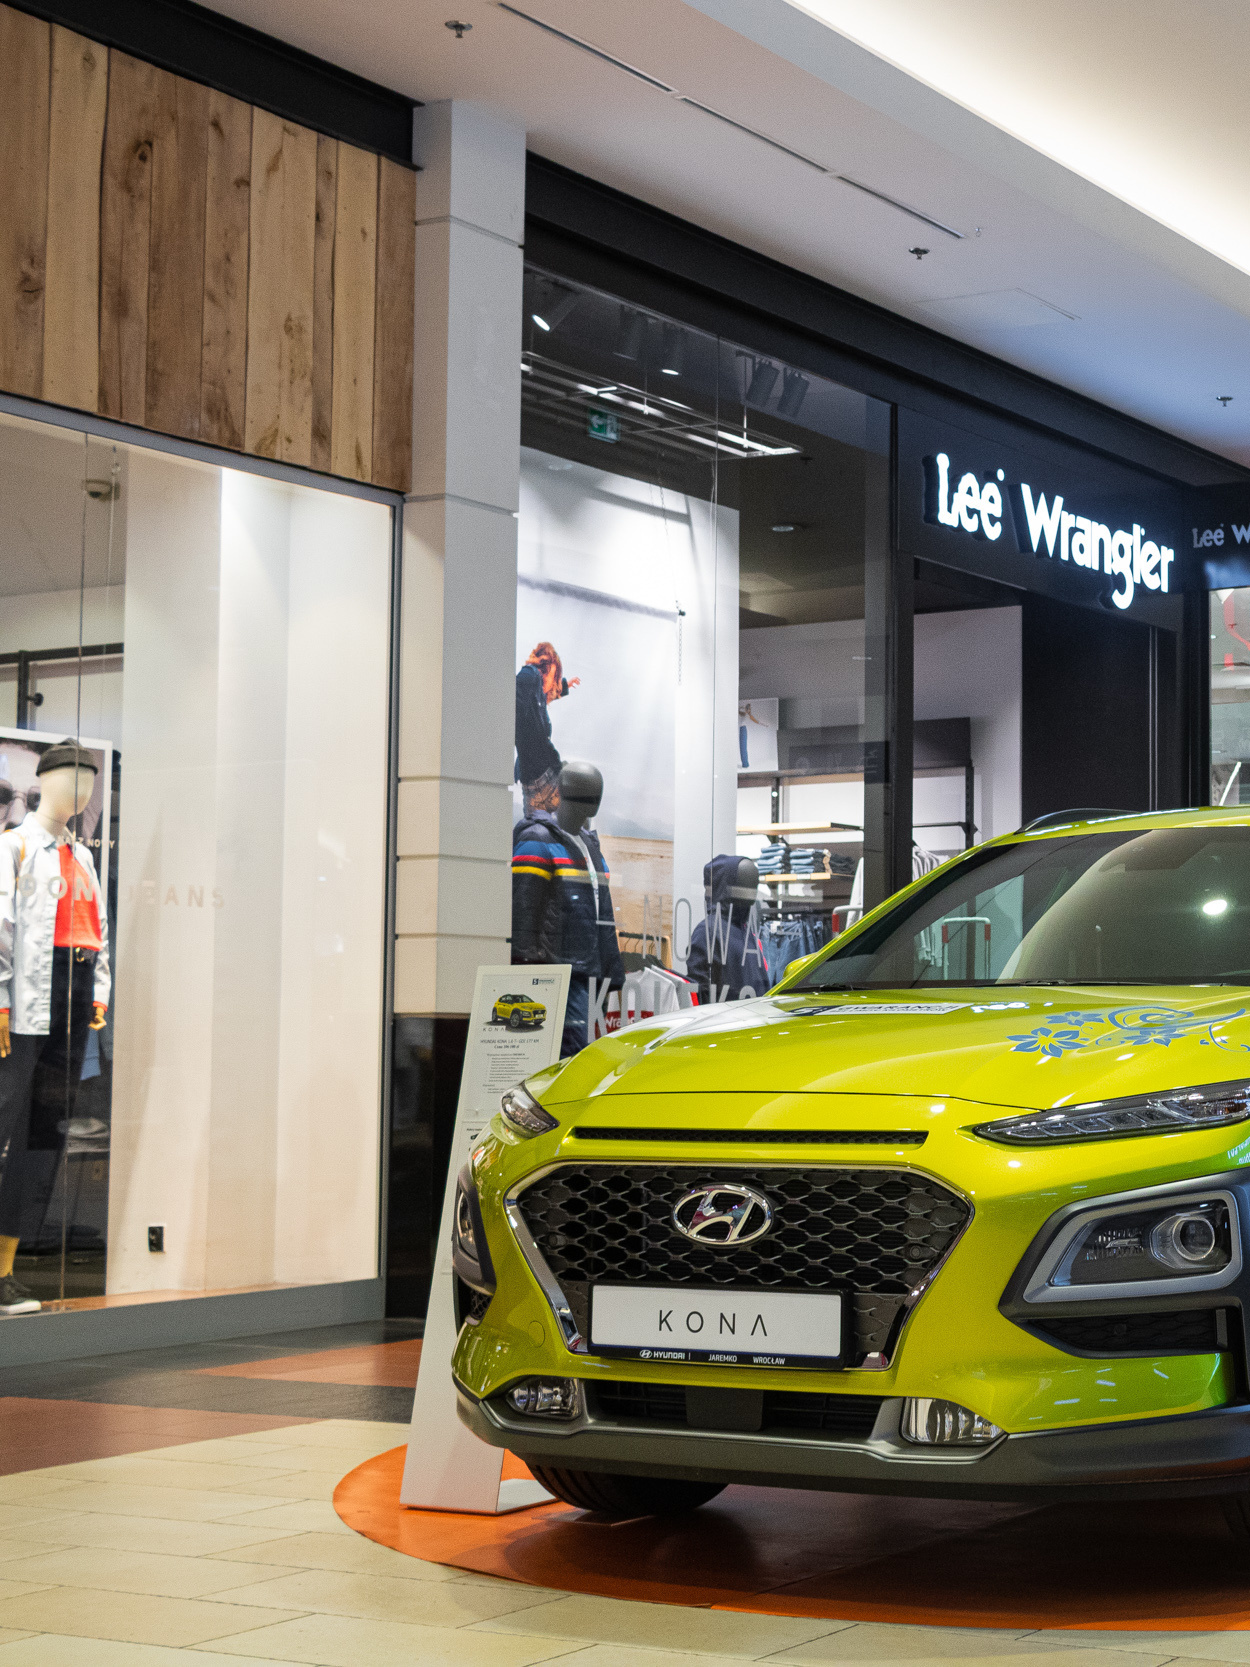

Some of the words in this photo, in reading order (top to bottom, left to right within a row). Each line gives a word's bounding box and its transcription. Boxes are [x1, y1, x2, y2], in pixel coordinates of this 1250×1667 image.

[936, 453, 1004, 541] Lee
[1021, 483, 1174, 609] Wrangler
[1192, 523, 1225, 548] Lee
[643, 894, 762, 968] NOWA
[658, 1309, 768, 1337] KONA
[653, 1350, 686, 1360] HYUNDAI
[708, 1353, 738, 1363] JAREMKO
[752, 1356, 786, 1366] WROCŁAW
